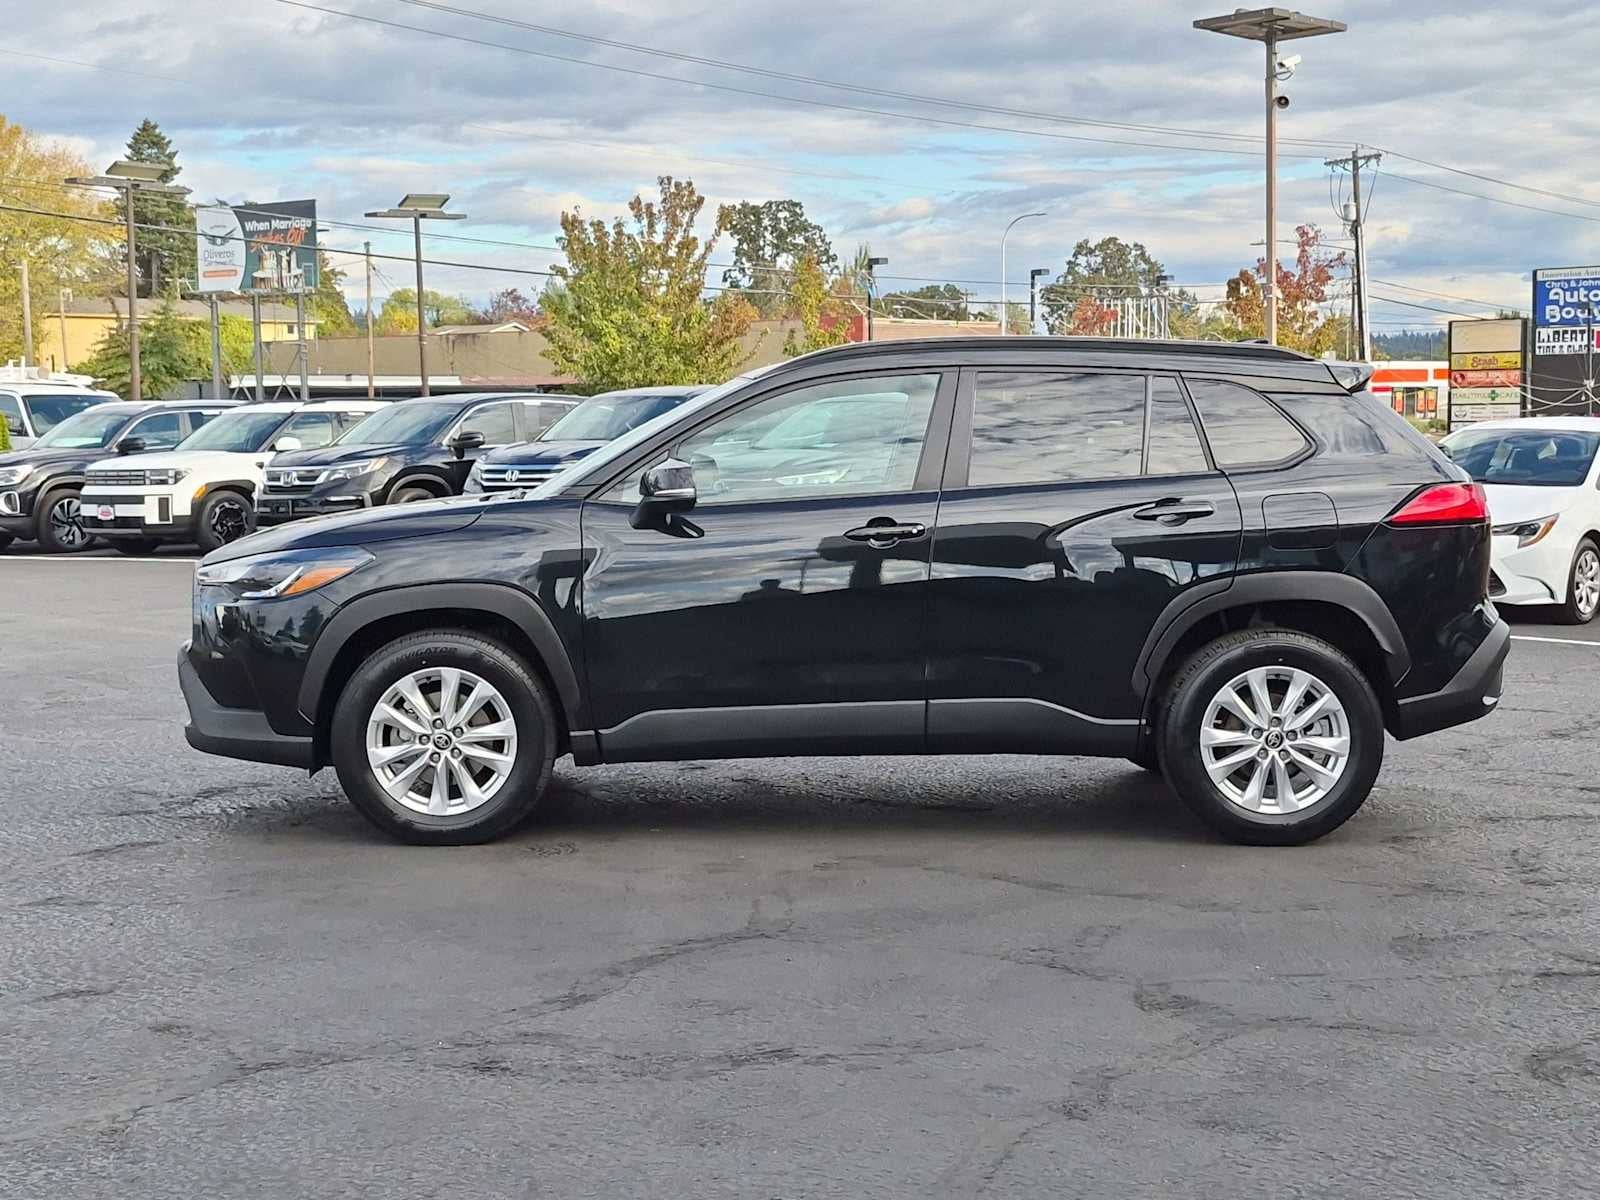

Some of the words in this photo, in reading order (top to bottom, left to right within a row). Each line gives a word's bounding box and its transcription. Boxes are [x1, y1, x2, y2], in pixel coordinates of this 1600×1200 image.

[245, 220, 270, 232] When
[271, 218, 312, 230] Marriage
[1549, 287, 1600, 306] Auto
